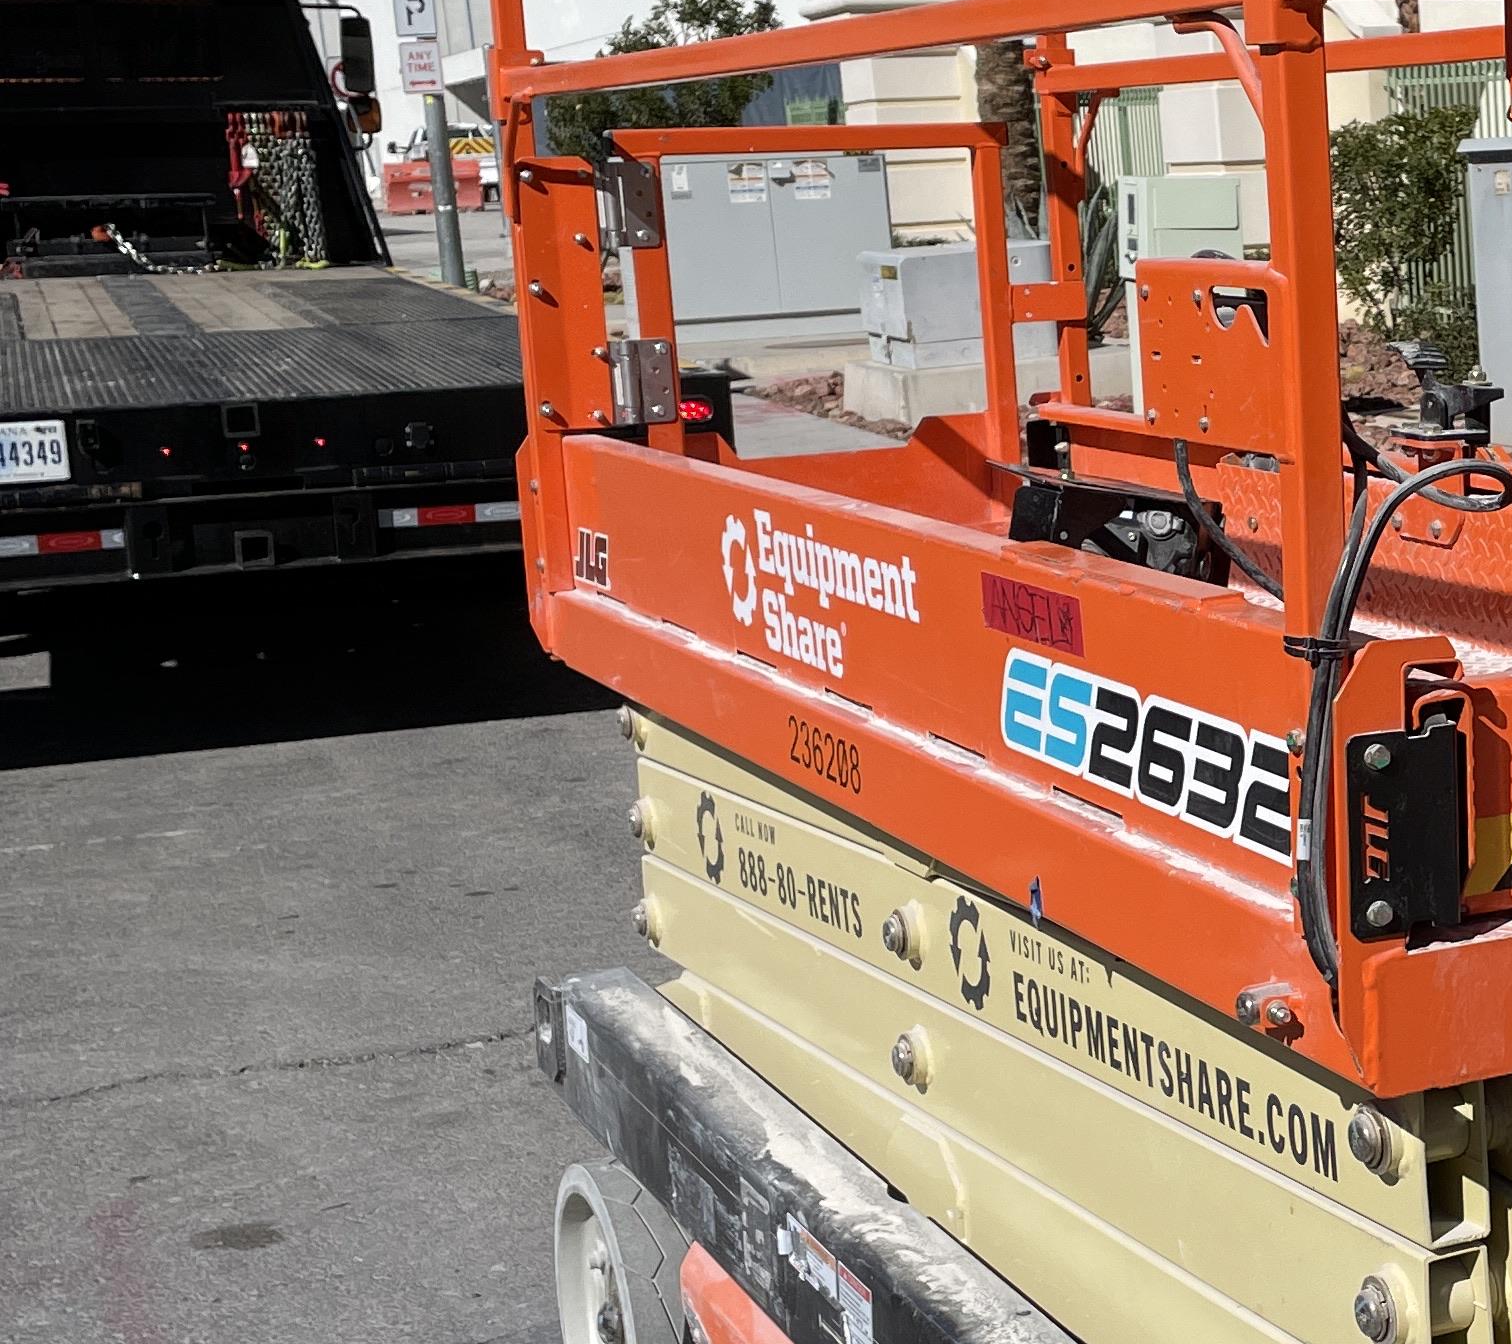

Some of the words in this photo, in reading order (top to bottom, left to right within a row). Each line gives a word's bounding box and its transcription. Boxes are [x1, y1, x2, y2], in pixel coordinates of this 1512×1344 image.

[407, 62, 434, 73] TIME
[408, 50, 433, 61] ANY
[574, 527, 611, 590] JLG
[753, 508, 920, 624] Equipment
[762, 588, 844, 678] Share
[788, 715, 861, 794] 236208
[1001, 647, 1293, 868] ES2632
[734, 813, 755, 838] CALL
[758, 821, 776, 845] NOW
[1361, 792, 1391, 884] JLG
[738, 847, 863, 939] 888-80-RENTS
[1009, 929, 1041, 964] VISIT
[1048, 946, 1064, 975] US
[1070, 957, 1090, 984] AT:
[1013, 971, 1339, 1183] EQUIPMENTSHARE.COM
